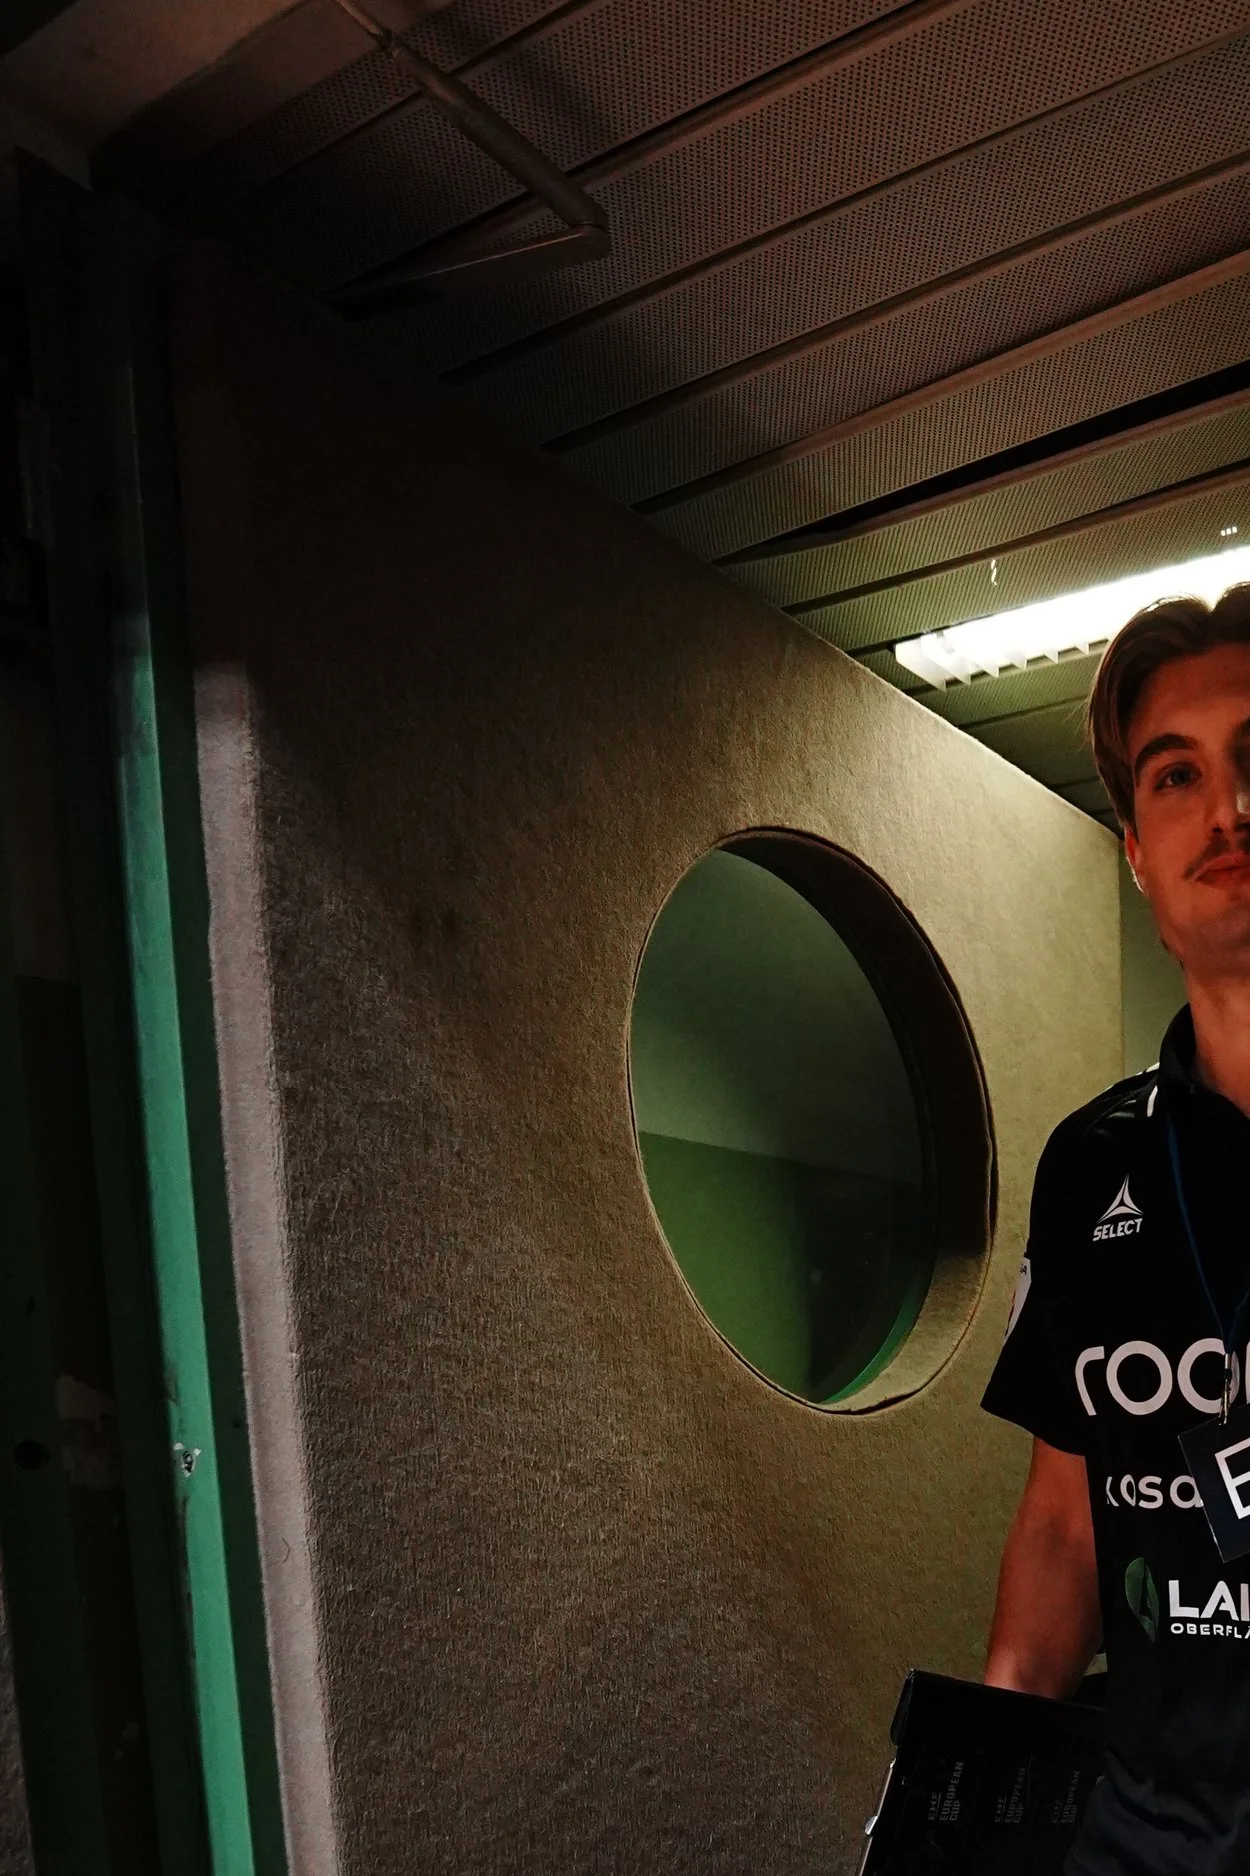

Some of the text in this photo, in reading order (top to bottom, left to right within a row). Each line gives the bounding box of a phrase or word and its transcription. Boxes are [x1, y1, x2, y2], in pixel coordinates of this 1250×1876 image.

[1092, 1218, 1143, 1242] SELECT
[939, 1761, 964, 1821] EUROPEAN
[927, 1791, 938, 1821] EHF
[949, 1799, 961, 1821] CUP
